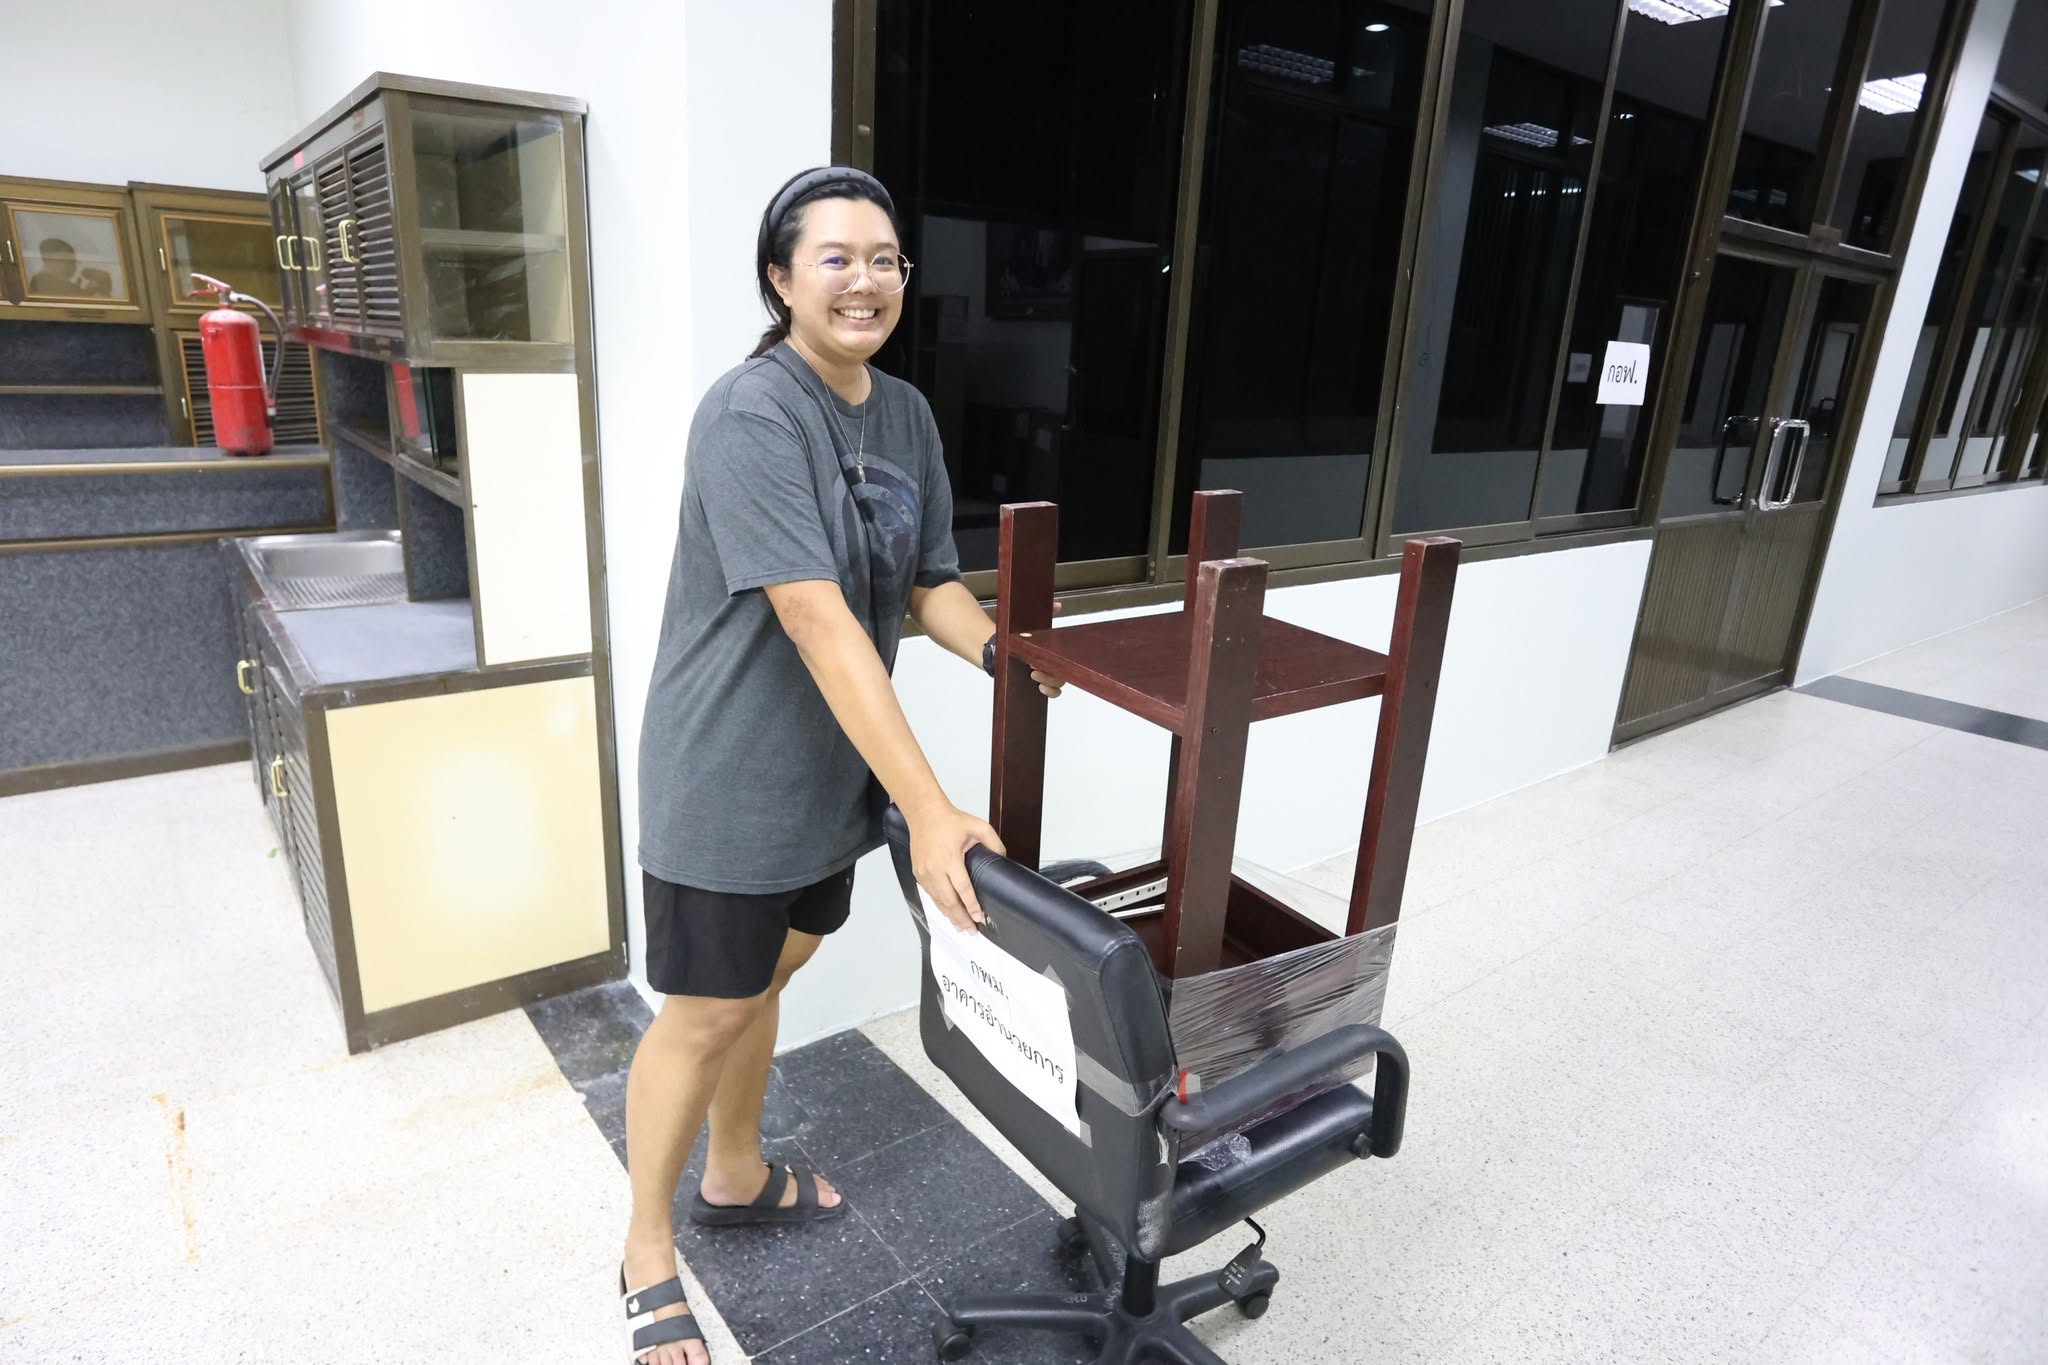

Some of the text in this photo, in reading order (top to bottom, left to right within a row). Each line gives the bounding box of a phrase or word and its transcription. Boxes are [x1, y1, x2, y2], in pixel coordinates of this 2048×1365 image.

[1607, 360, 1637, 384] กอฟ.
[942, 975, 1064, 1083] อาคารอำนวยการ
